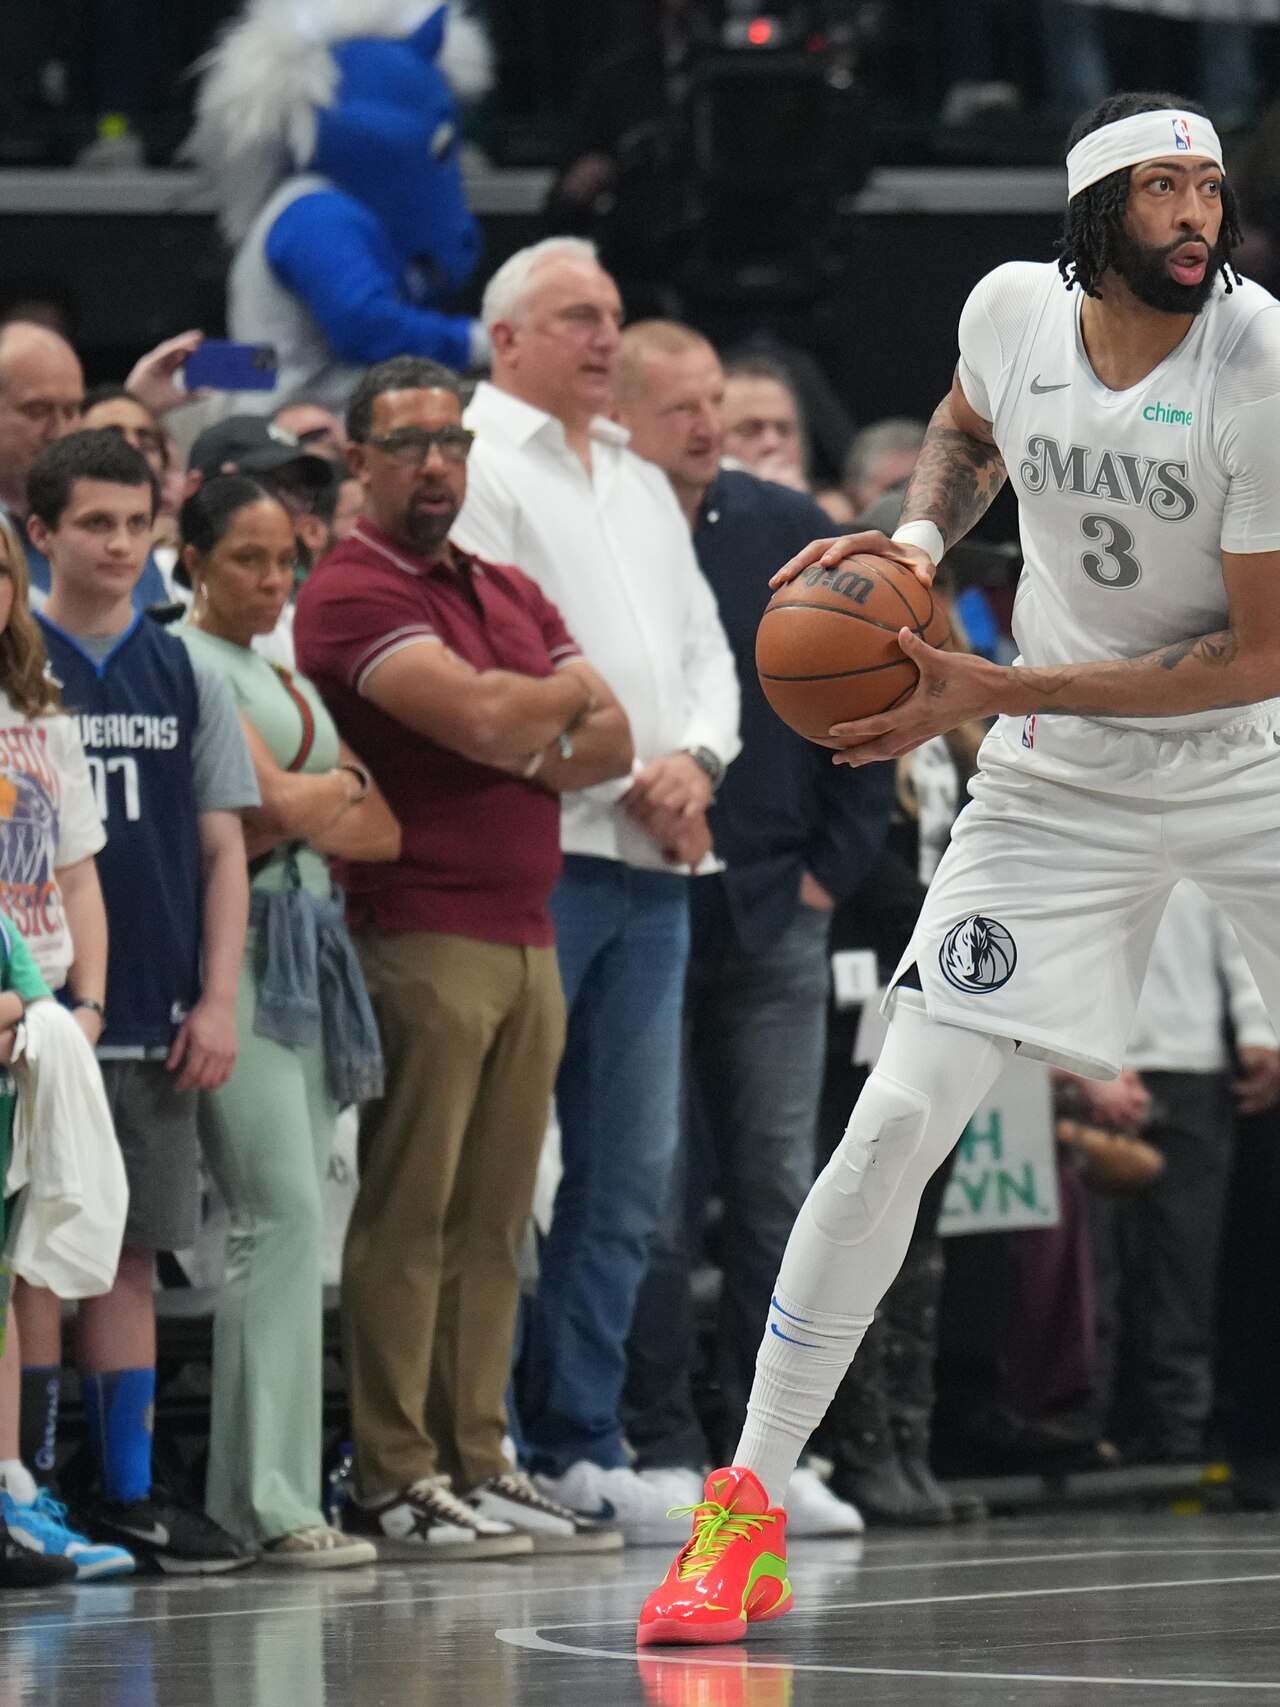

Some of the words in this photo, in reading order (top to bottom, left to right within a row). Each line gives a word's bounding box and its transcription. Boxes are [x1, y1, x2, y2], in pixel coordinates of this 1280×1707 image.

[1143, 401, 1193, 426] chime
[1020, 434, 1197, 522] MAVS
[1080, 512, 1142, 590] 3
